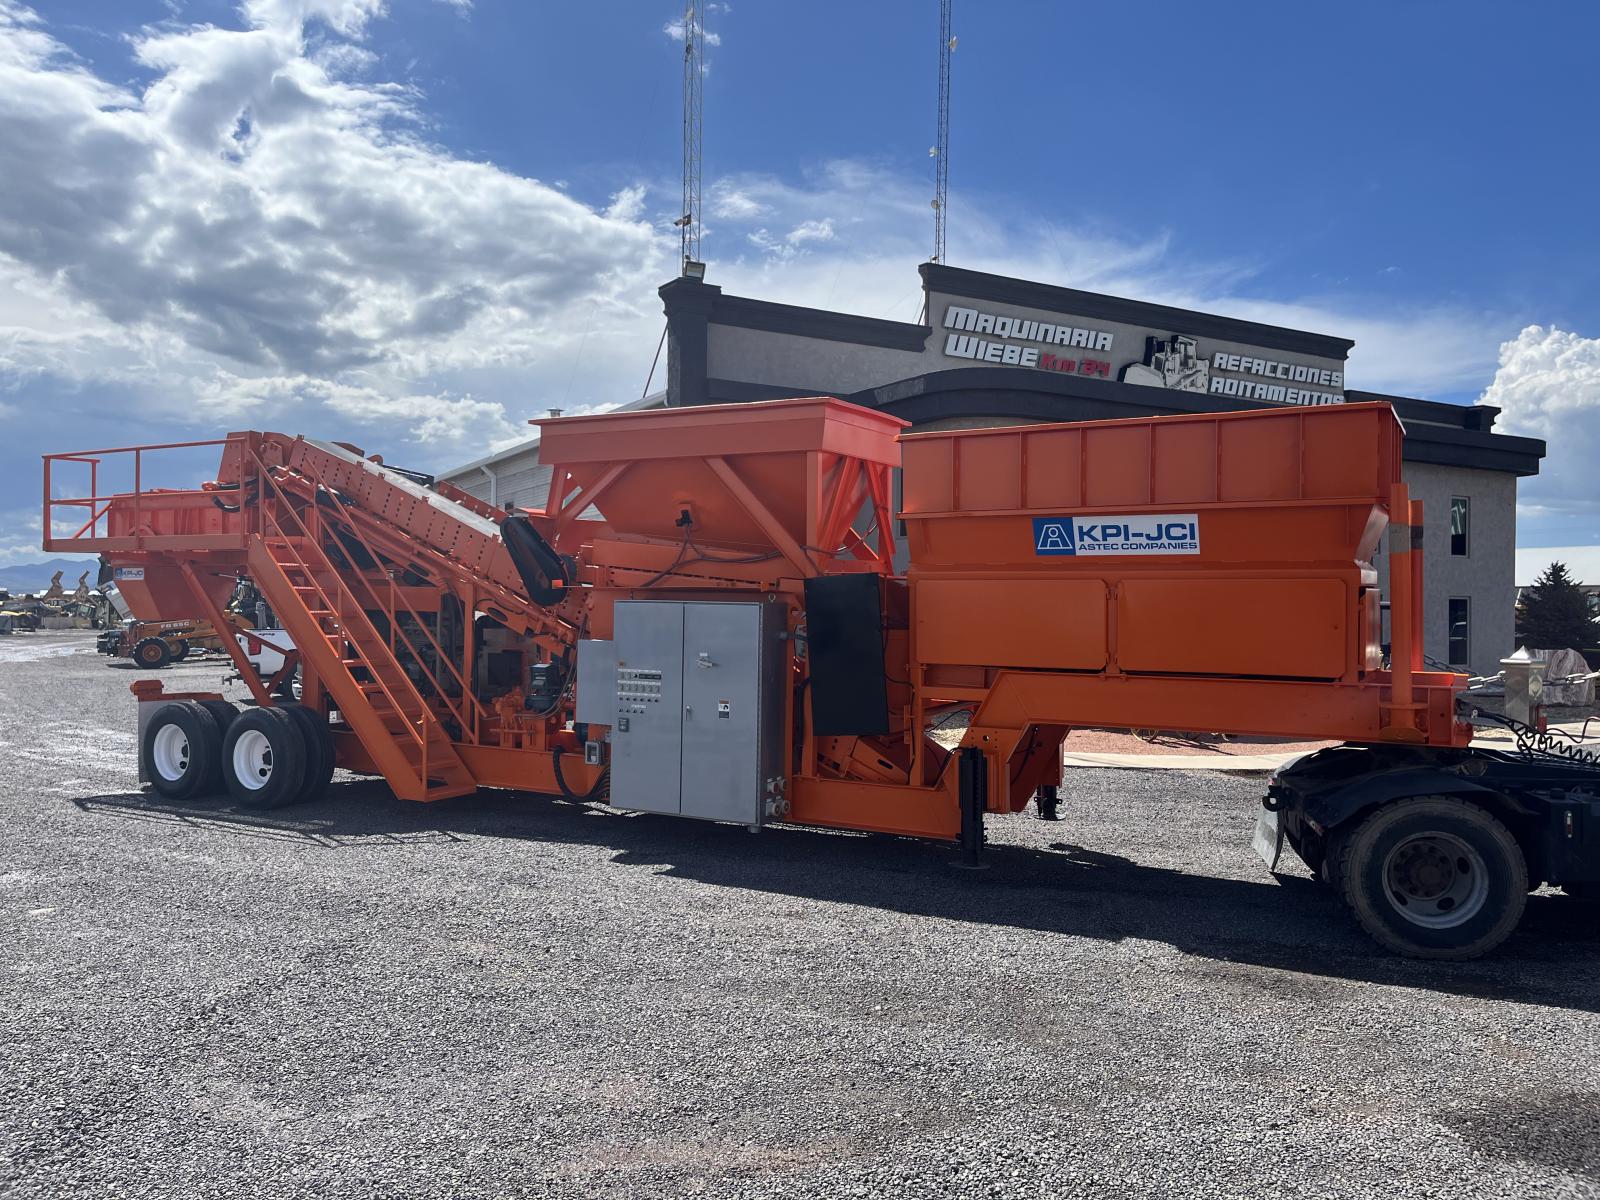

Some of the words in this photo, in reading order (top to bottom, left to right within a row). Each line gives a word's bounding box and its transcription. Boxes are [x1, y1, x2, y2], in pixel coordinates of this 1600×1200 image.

[944, 306, 1114, 351] MAQUINARIA
[945, 334, 1039, 367] WIEBE
[1040, 352, 1076, 373] Km
[1213, 352, 1344, 387] REFACCIONES
[1210, 377, 1346, 406] ADITAMENTOS
[1077, 523, 1196, 542] KPI-JCI
[1078, 543, 1119, 551] ASTEC
[1121, 542, 1197, 550] COMPANIES
